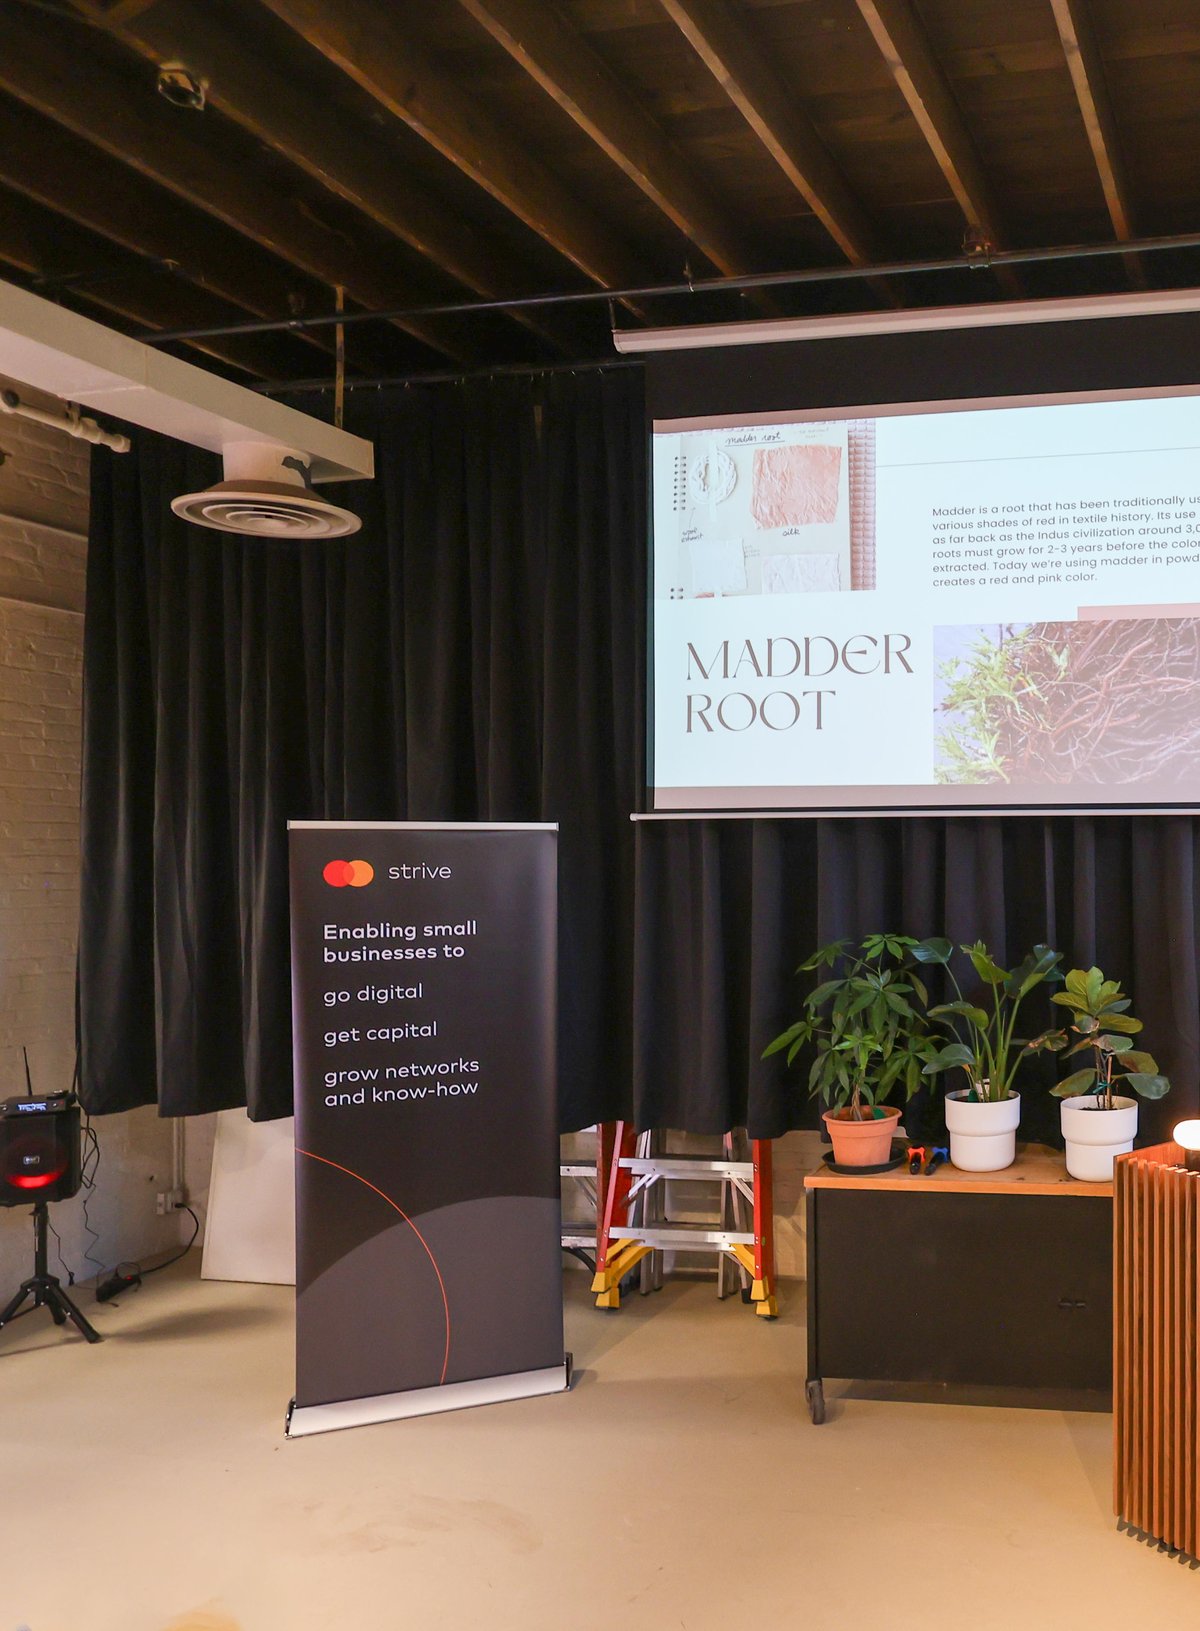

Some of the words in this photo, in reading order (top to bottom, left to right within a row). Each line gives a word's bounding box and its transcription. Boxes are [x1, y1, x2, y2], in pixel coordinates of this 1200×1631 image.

[932, 506, 976, 516] Madder
[979, 505, 988, 514] is
[991, 506, 999, 514] a
[1002, 504, 1025, 513] root
[1028, 502, 1052, 512] that
[1055, 501, 1077, 510] has
[1080, 500, 1110, 509] been
[1113, 495, 1185, 508] traditionally
[932, 520, 974, 531] various
[977, 518, 1019, 529] shades
[1021, 517, 1033, 527] of
[1036, 516, 1055, 526] red
[1059, 515, 1069, 525] in
[1072, 514, 1108, 524] textile
[1111, 512, 1154, 523] history.
[1157, 511, 1171, 520] Its
[1174, 511, 1196, 519] use
[932, 537, 946, 545] as
[949, 534, 965, 544] far
[968, 533, 996, 543] back
[999, 534, 1013, 542] as
[1016, 532, 1035, 541] the
[1038, 530, 1070, 540] Indus
[1072, 527, 1135, 539] civilization
[1138, 524, 1182, 536] around
[932, 550, 962, 559] roots
[964, 548, 994, 557] must
[996, 548, 1025, 559] grow
[1028, 545, 1044, 555] for
[1047, 544, 1067, 554] 2-3
[1070, 544, 1103, 555] years
[1106, 541, 1145, 551] before
[1148, 540, 1168, 550] the
[932, 561, 989, 573] extracted.
[993, 561, 1028, 572] Today
[1031, 560, 1062, 569] we're
[1065, 558, 1097, 569] using
[1100, 555, 1148, 566] madder
[1152, 554, 1163, 564] in
[932, 577, 976, 587] creates
[989, 575, 1008, 585] red
[1011, 574, 1035, 584] and
[1038, 573, 1062, 585] pink
[1065, 572, 1097, 582] color.
[686, 633, 914, 680] MADDER
[686, 690, 836, 733] ROOT
[388, 862, 452, 879] strive
[323, 923, 416, 941] Enabling
[423, 920, 477, 937] small
[323, 946, 437, 963] businesses
[443, 944, 465, 958] to
[323, 990, 350, 1007] go
[357, 982, 423, 1004] digital
[324, 1028, 360, 1047] get
[366, 1020, 437, 1043] capital
[324, 1067, 378, 1087] grow
[386, 1057, 480, 1079] networks
[324, 1089, 365, 1107] and
[373, 1081, 479, 1103] know-how
